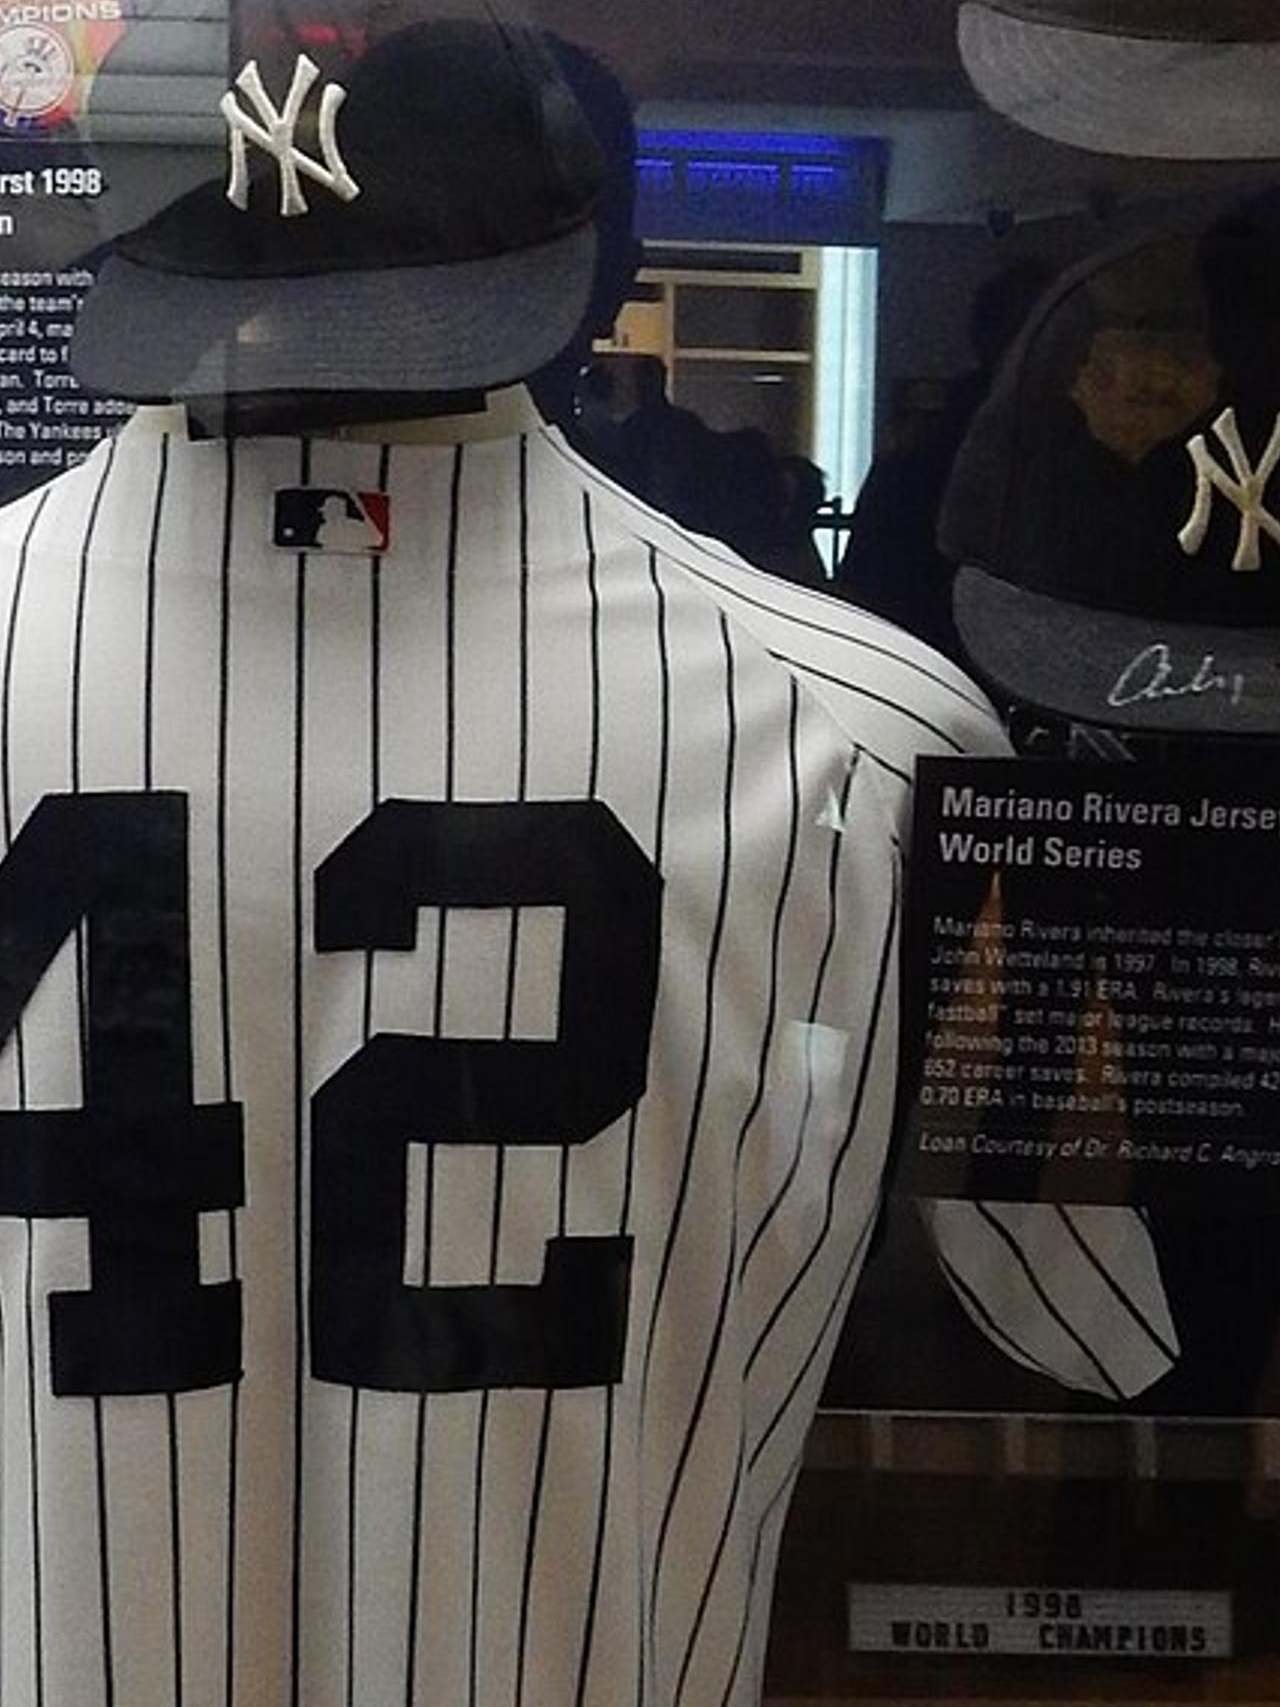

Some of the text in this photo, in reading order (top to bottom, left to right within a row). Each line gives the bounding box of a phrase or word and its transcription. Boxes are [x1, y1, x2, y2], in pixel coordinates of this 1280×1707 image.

[42, 168, 101, 195] 1998
[56, 269, 93, 287] with
[943, 786, 1072, 821] Mariano
[1083, 793, 1180, 826] Rivera
[940, 832, 1141, 869] World Series
[891, 1621, 1205, 1652] WORLD CHAMPIONS
